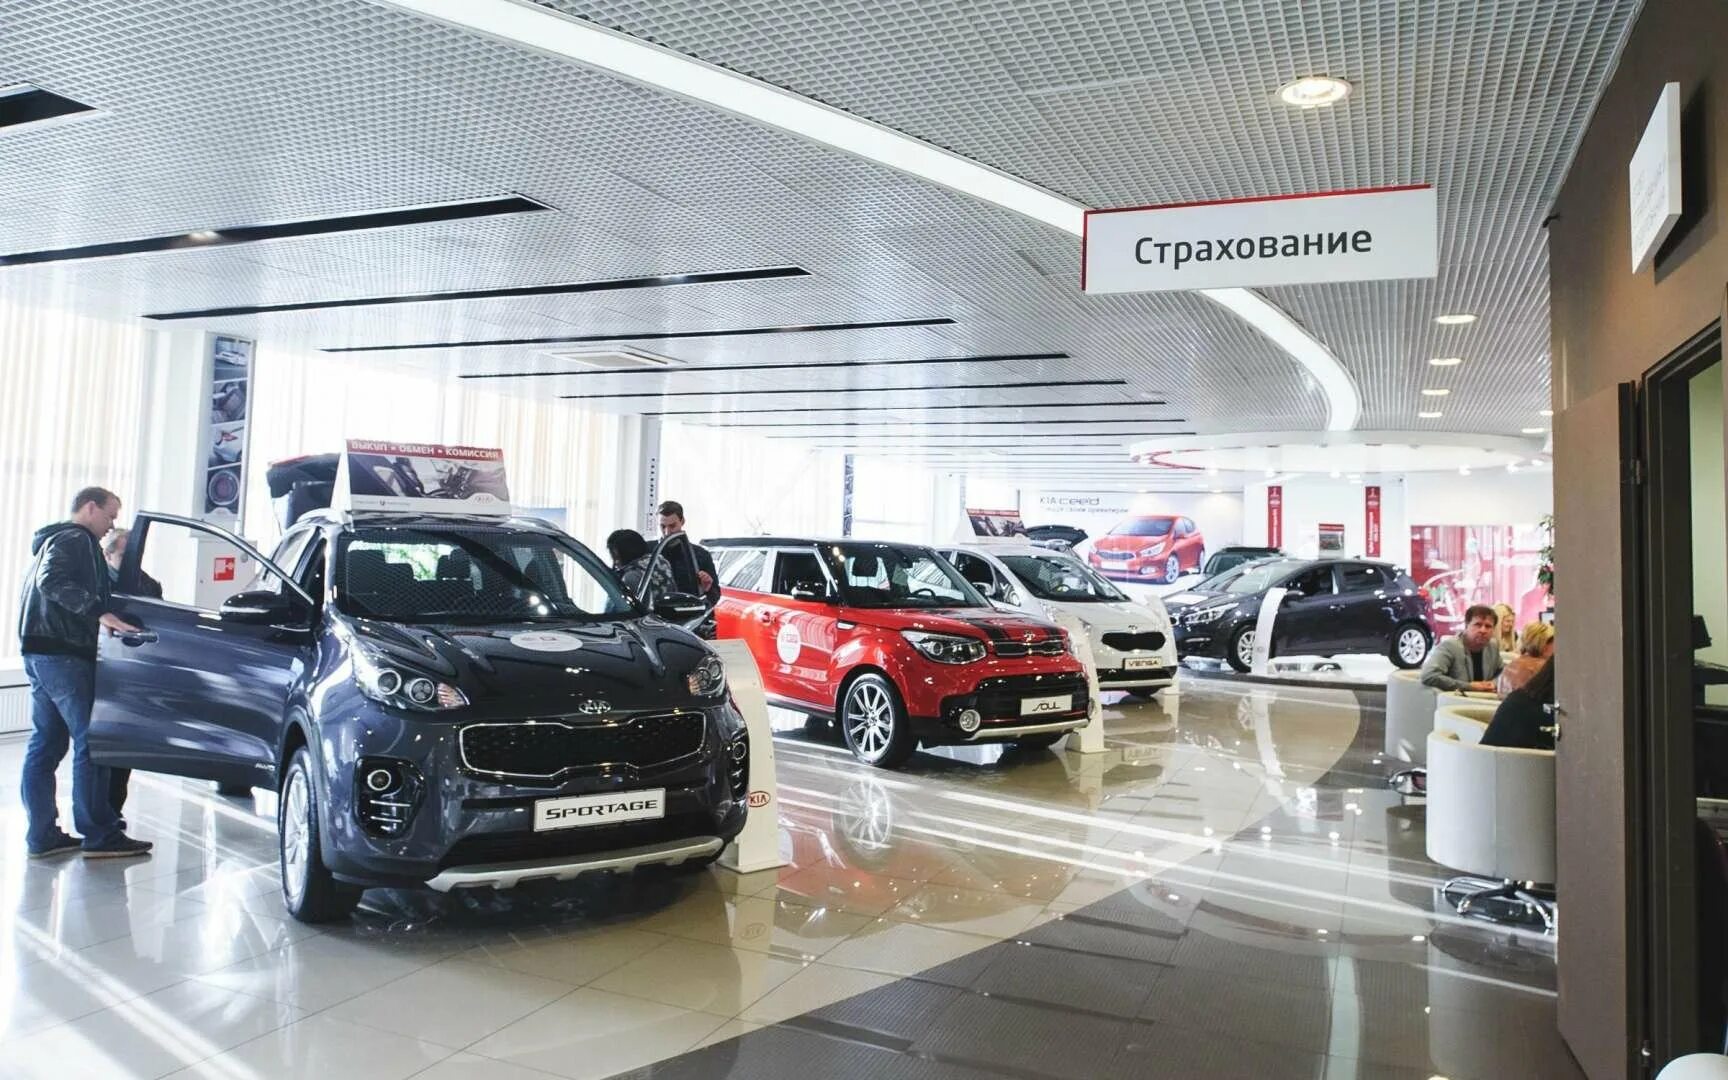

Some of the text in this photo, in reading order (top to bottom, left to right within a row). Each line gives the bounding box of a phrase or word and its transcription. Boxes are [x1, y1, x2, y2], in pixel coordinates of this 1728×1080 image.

[1134, 228, 1373, 270] Страхование
[351, 441, 500, 459] ВЫКУП ОБМЕН КОМИССИЯ
[545, 799, 658, 820] SPORTAGE
